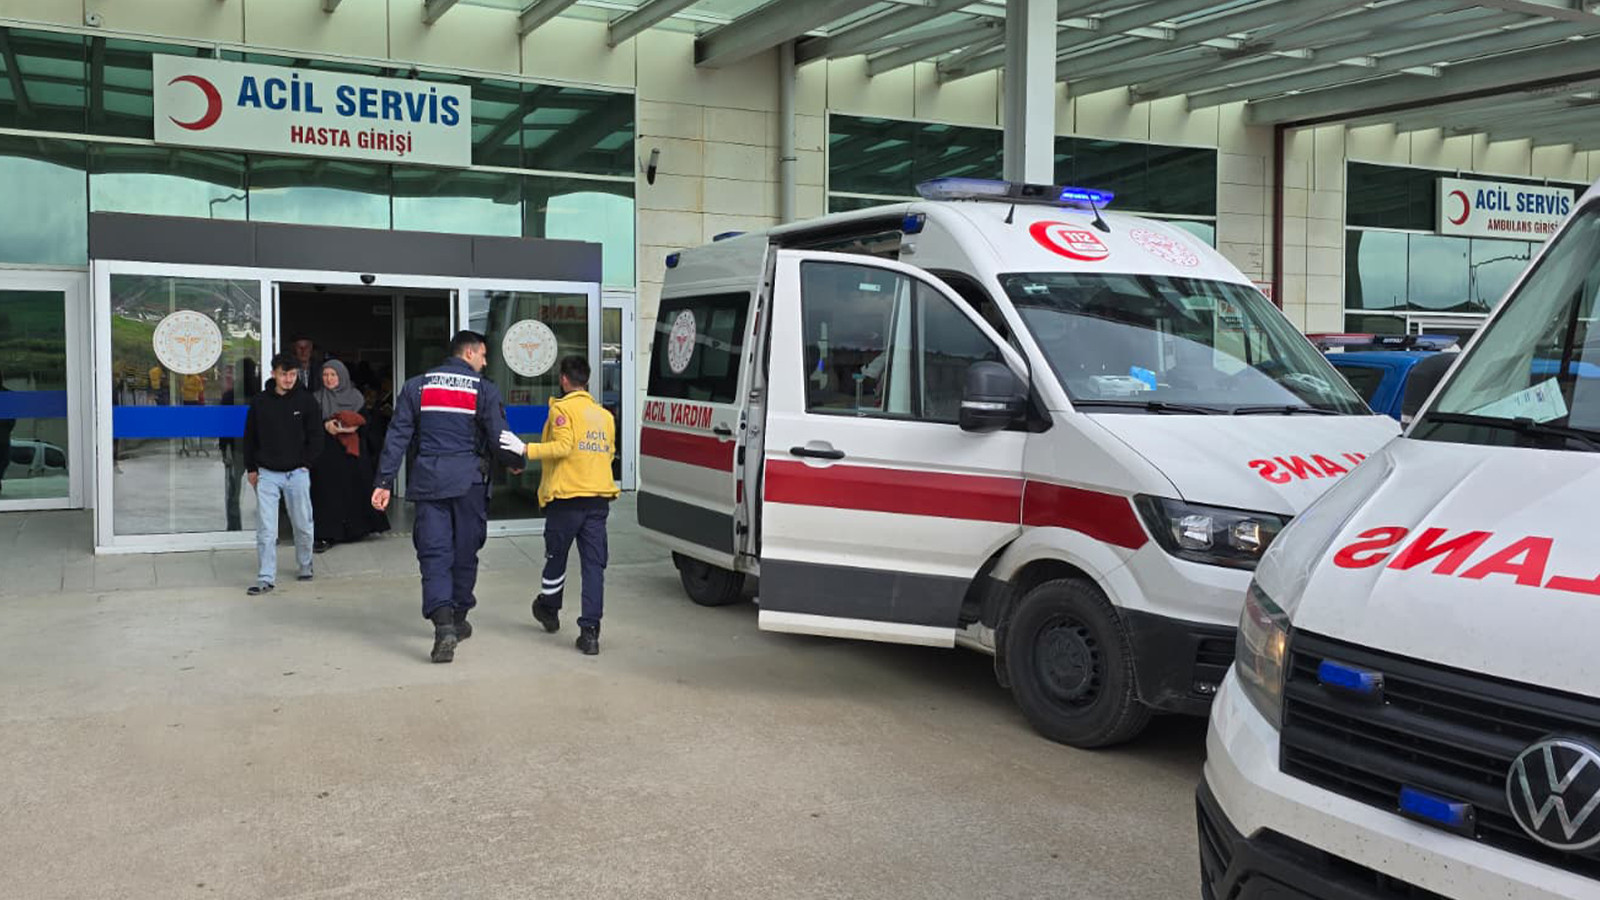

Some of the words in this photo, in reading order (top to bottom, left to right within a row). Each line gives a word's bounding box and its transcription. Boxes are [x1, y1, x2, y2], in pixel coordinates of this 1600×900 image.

[237, 73, 322, 114] ACİL
[336, 85, 460, 126] SERVİS
[290, 125, 350, 148] HASTA
[358, 128, 412, 156] GİRİŞİ
[1475, 186, 1511, 211] ACİL
[1516, 190, 1570, 216] SERVİS
[1066, 231, 1094, 243] 112
[1487, 218, 1532, 234] AMBULANS
[645, 400, 666, 422] ACİL
[670, 402, 713, 429] YARDIM
